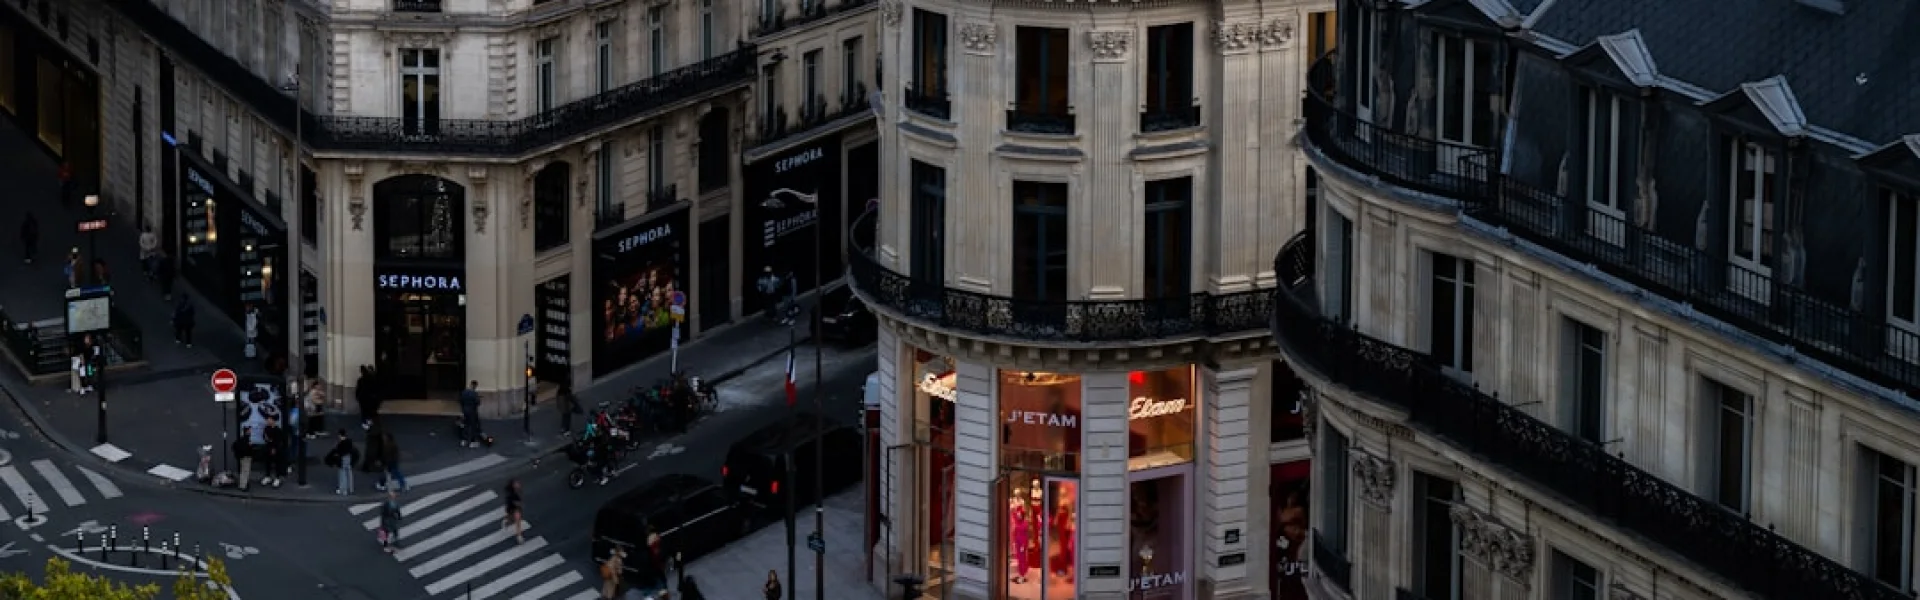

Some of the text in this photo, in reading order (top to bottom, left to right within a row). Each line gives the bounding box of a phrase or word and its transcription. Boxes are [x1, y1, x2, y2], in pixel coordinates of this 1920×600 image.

[617, 222, 671, 253] SEPHORA
[379, 274, 461, 289] SEPHORA
[1007, 410, 1077, 429] J'ETAM
